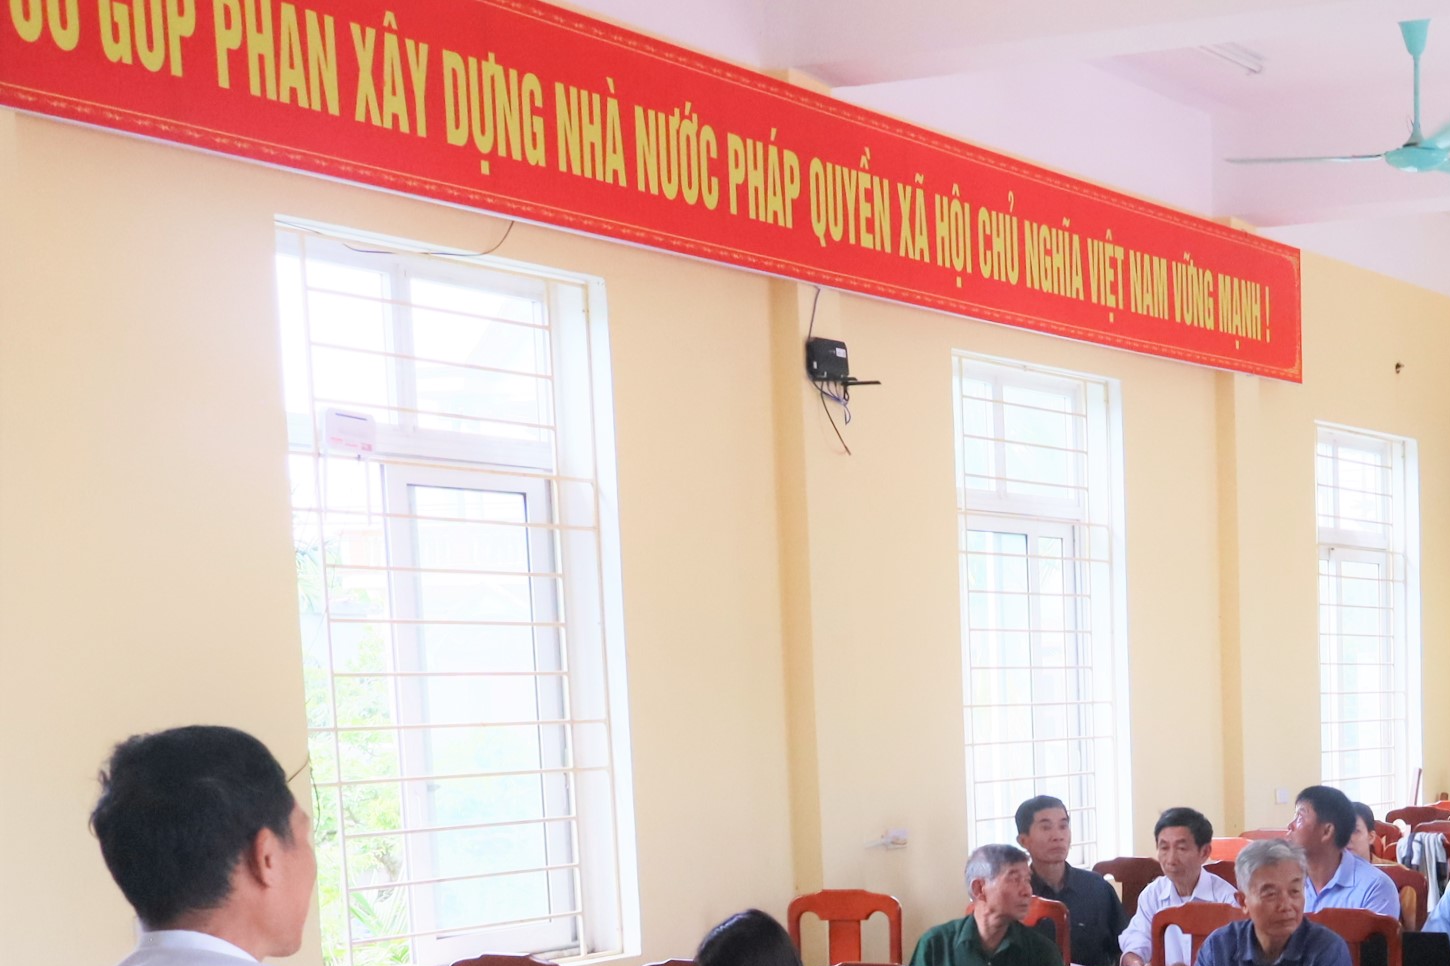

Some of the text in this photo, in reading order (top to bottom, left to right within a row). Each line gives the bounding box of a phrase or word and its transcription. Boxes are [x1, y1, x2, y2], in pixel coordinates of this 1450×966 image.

[350, 10, 428, 138] XÂY
[442, 51, 546, 175] DỰNG
[555, 76, 627, 187] NHÀ
[635, 101, 719, 210] NƯỚC
[727, 127, 800, 229] PHÁP
[809, 146, 892, 254] QUYỀN
[897, 172, 930, 263] XÃ
[935, 183, 972, 288] HỘI
[978, 190, 1019, 285] CHỦ
[1024, 216, 1085, 301] NGHĨA
[1087, 228, 1124, 323] VIỆT
[1129, 249, 1169, 320] NAM
[1171, 251, 1214, 330] VỮNG
[1217, 273, 1261, 350] MẠNH
